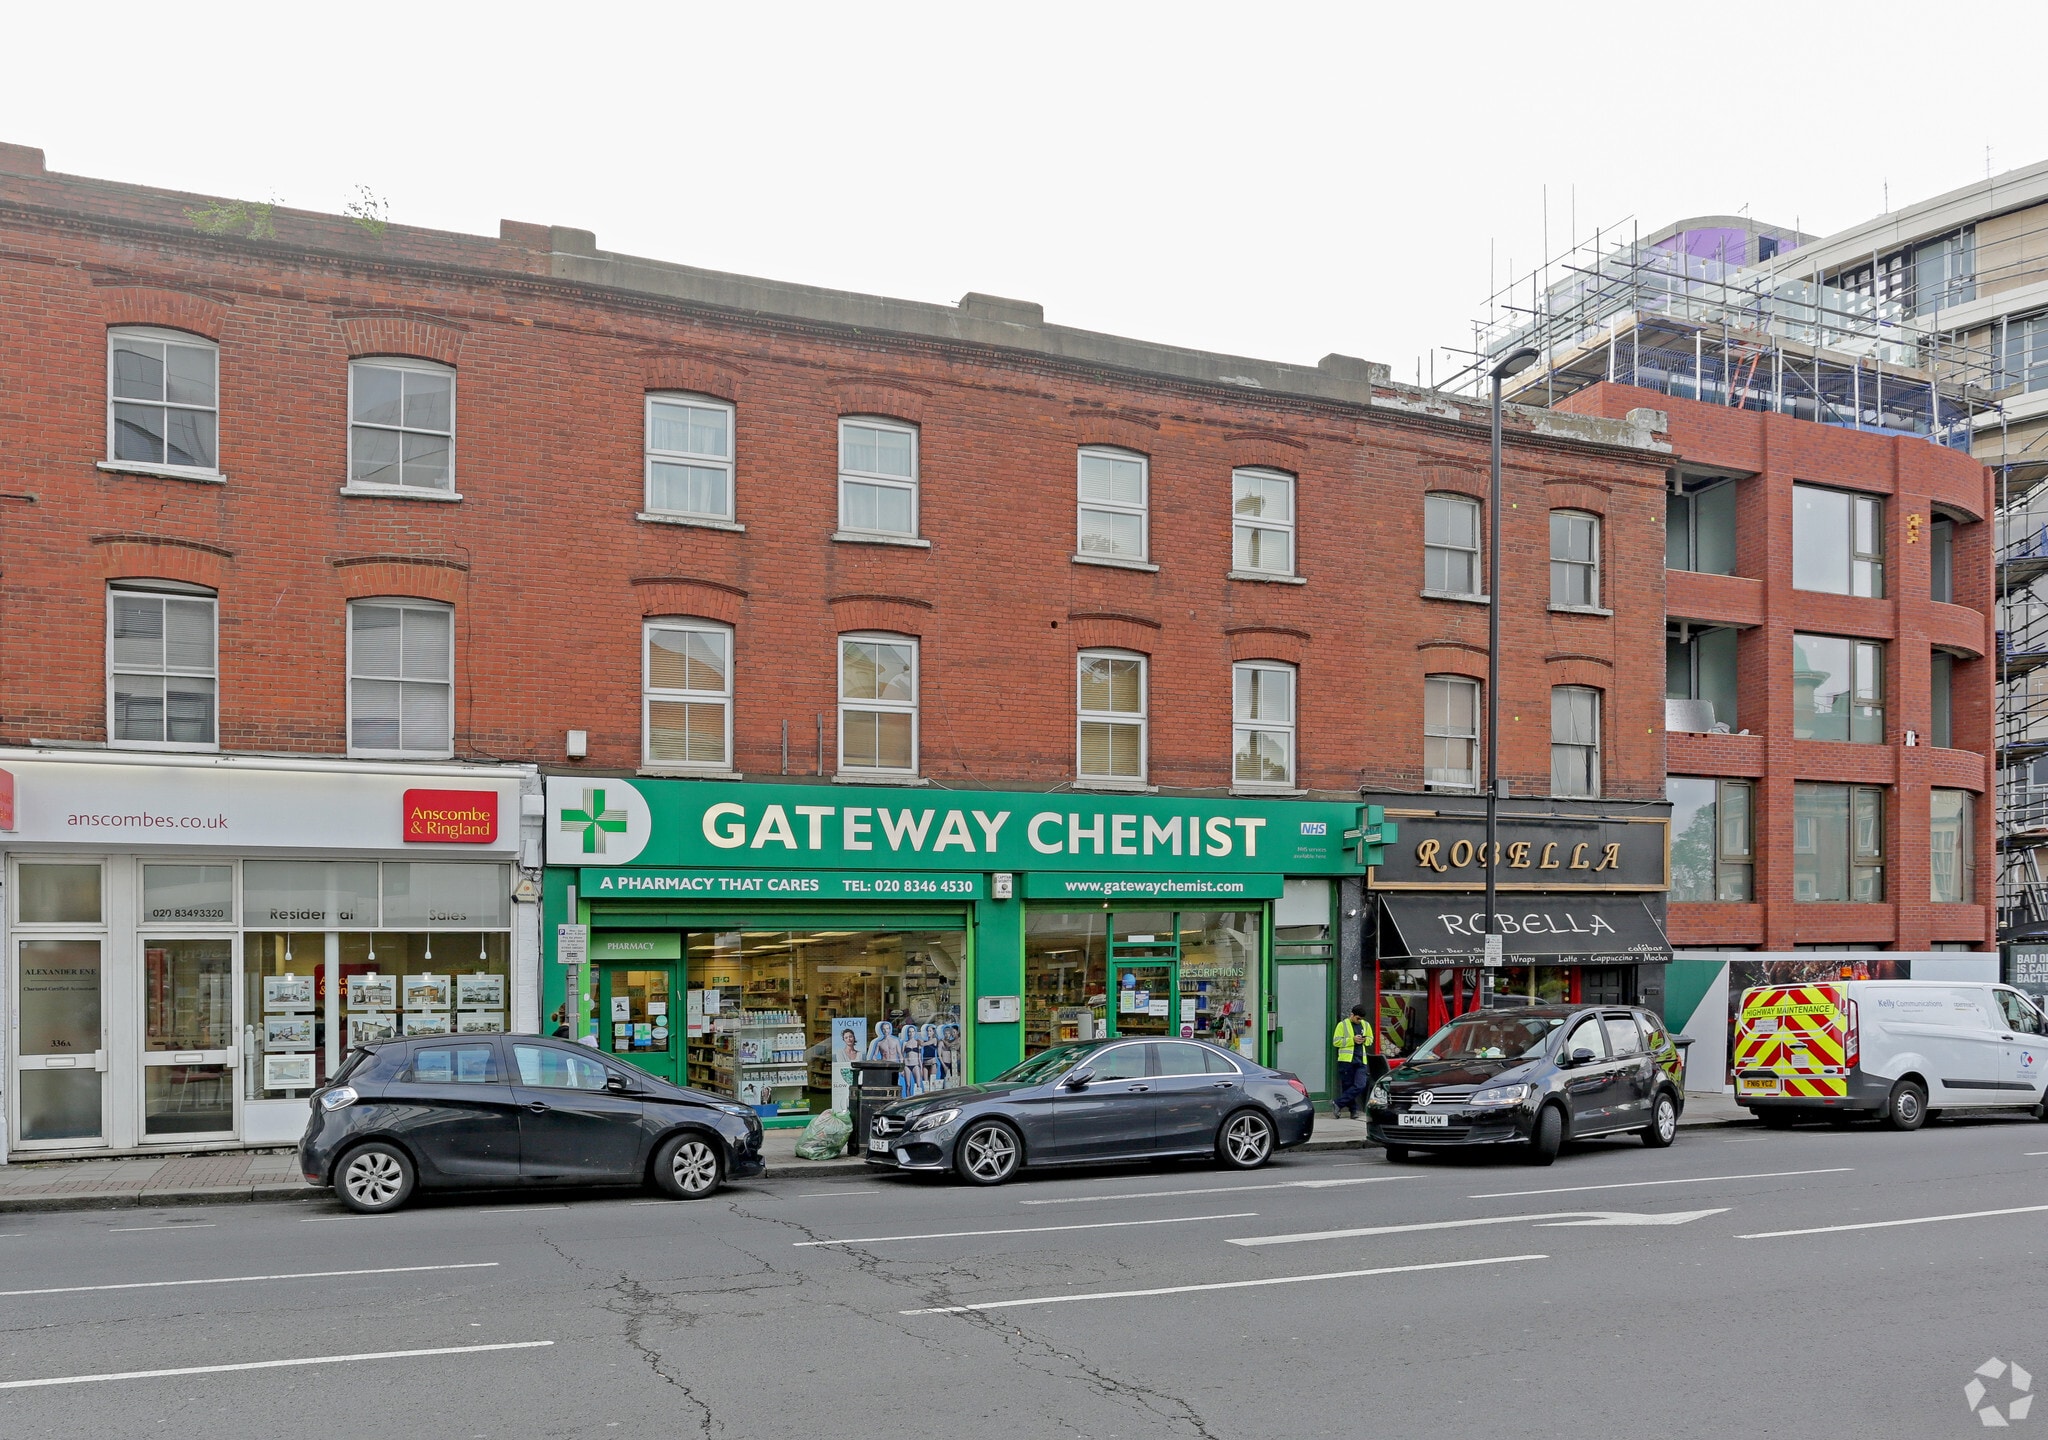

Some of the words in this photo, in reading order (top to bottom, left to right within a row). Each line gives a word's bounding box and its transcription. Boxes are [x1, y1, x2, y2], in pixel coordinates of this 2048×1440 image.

[411, 807, 490, 821] Anscombe
[67, 812, 229, 829] anscombes.co.uk
[410, 821, 423, 834] &
[427, 822, 490, 839] Ringland
[701, 803, 1011, 853] GATEWAY
[1027, 812, 1267, 857] CHEMIST
[1302, 824, 1325, 834] NHS
[1416, 838, 1621, 873] ROBELLA
[600, 877, 613, 890] A
[617, 877, 715, 891] PHARMACY
[718, 878, 765, 891] THAT
[767, 878, 819, 892] CARES
[842, 880, 871, 892] TEL:
[874, 880, 900, 892] 020
[903, 880, 937, 893] 8346
[940, 880, 973, 893] 4530
[1065, 879, 1244, 895] www.gatewaychemist.com
[152, 909, 172, 917] 020
[174, 909, 224, 918] 83493320
[270, 908, 354, 920] Resideal
[429, 909, 467, 921] Sales
[1437, 912, 1616, 936] ROBELLA
[607, 942, 655, 950] PHARMACY
[1420, 955, 1455, 965] Ciabatta
[1468, 955, 1485, 963] Pan
[1510, 954, 1536, 965] Wraps
[1558, 954, 1578, 963] Latte
[1590, 953, 1633, 964] Cappuccino
[1643, 954, 1668, 962] Mocha
[2017, 954, 2037, 963] BAD
[2017, 964, 2026, 973] IS
[1746, 1007, 1775, 1016] HIGHWAY
[1776, 1004, 1830, 1015] MAINTENANCE
[1878, 999, 1895, 1009] Kelly
[1896, 999, 1943, 1008] Communications
[1403, 1115, 1422, 1125] GM14
